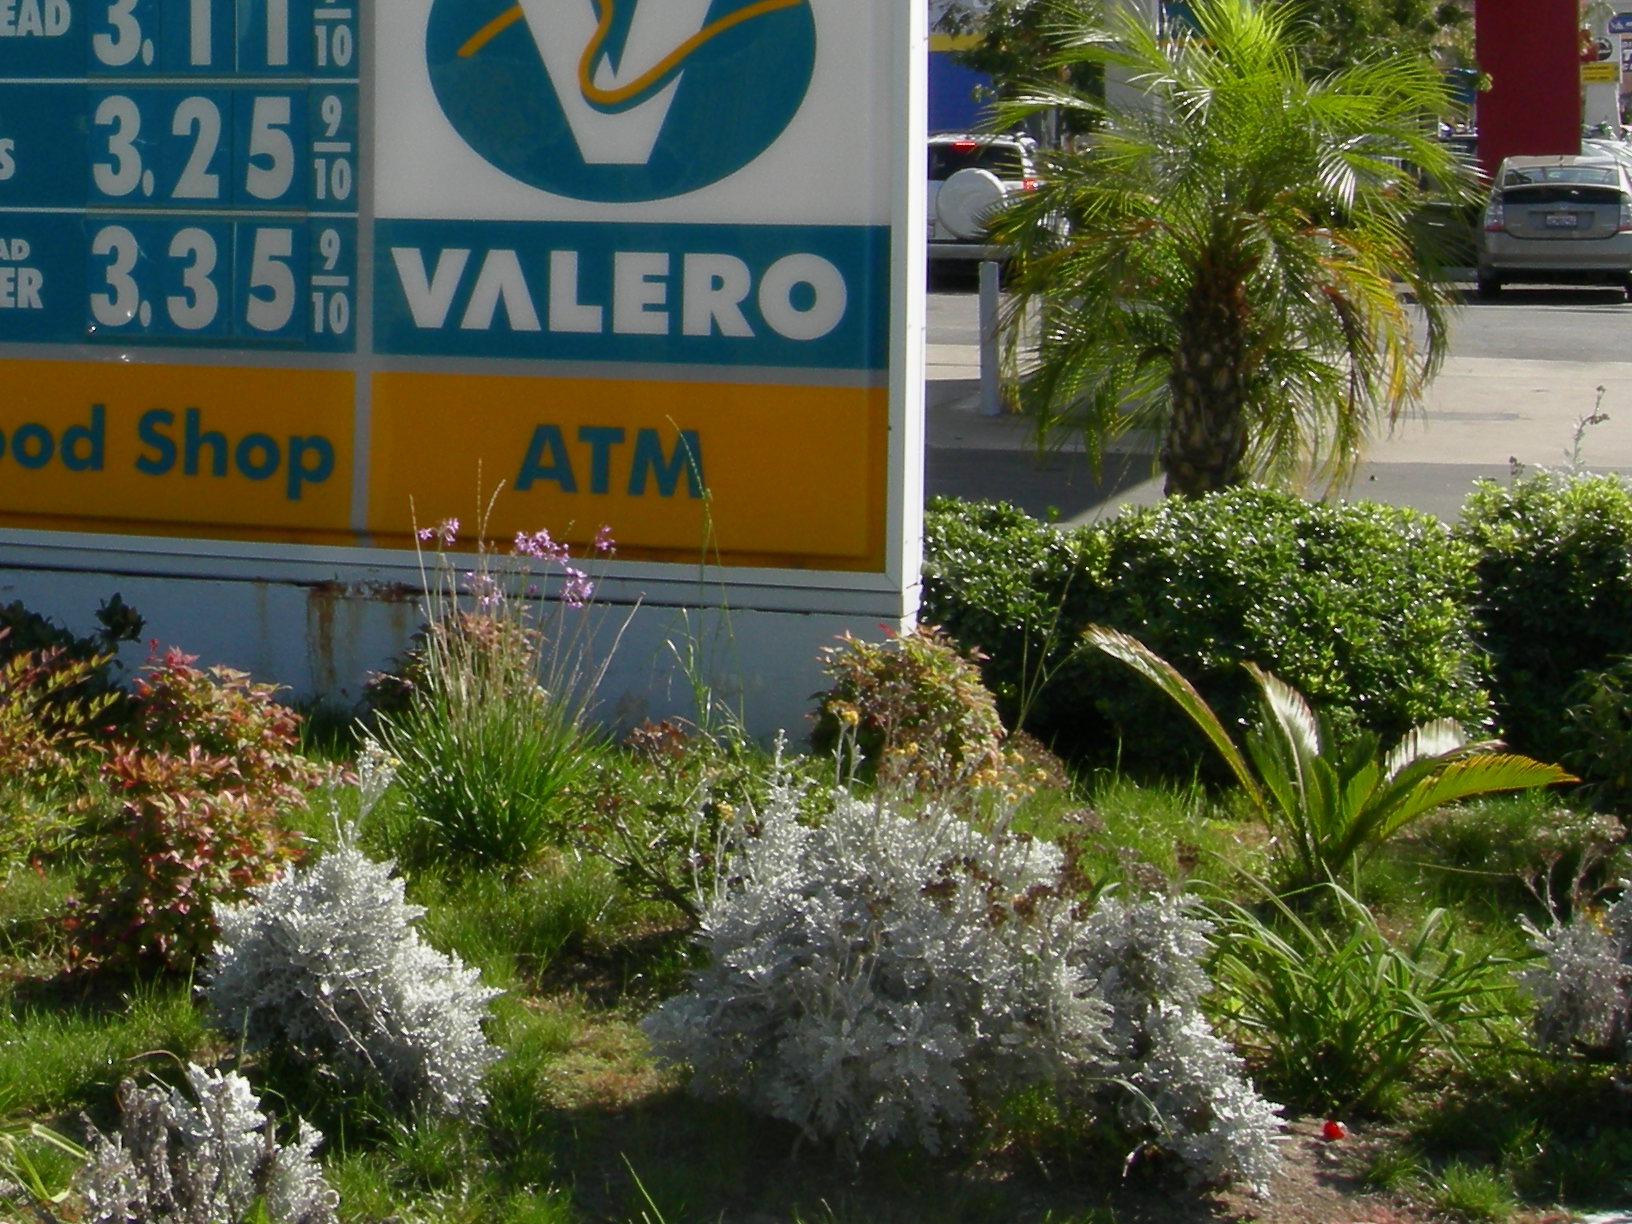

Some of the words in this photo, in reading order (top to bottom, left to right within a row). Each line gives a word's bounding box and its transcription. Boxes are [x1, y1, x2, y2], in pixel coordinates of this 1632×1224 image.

[390, 247, 848, 341] VALERO
[136, 408, 336, 501] Shop
[513, 423, 706, 500] ATM
